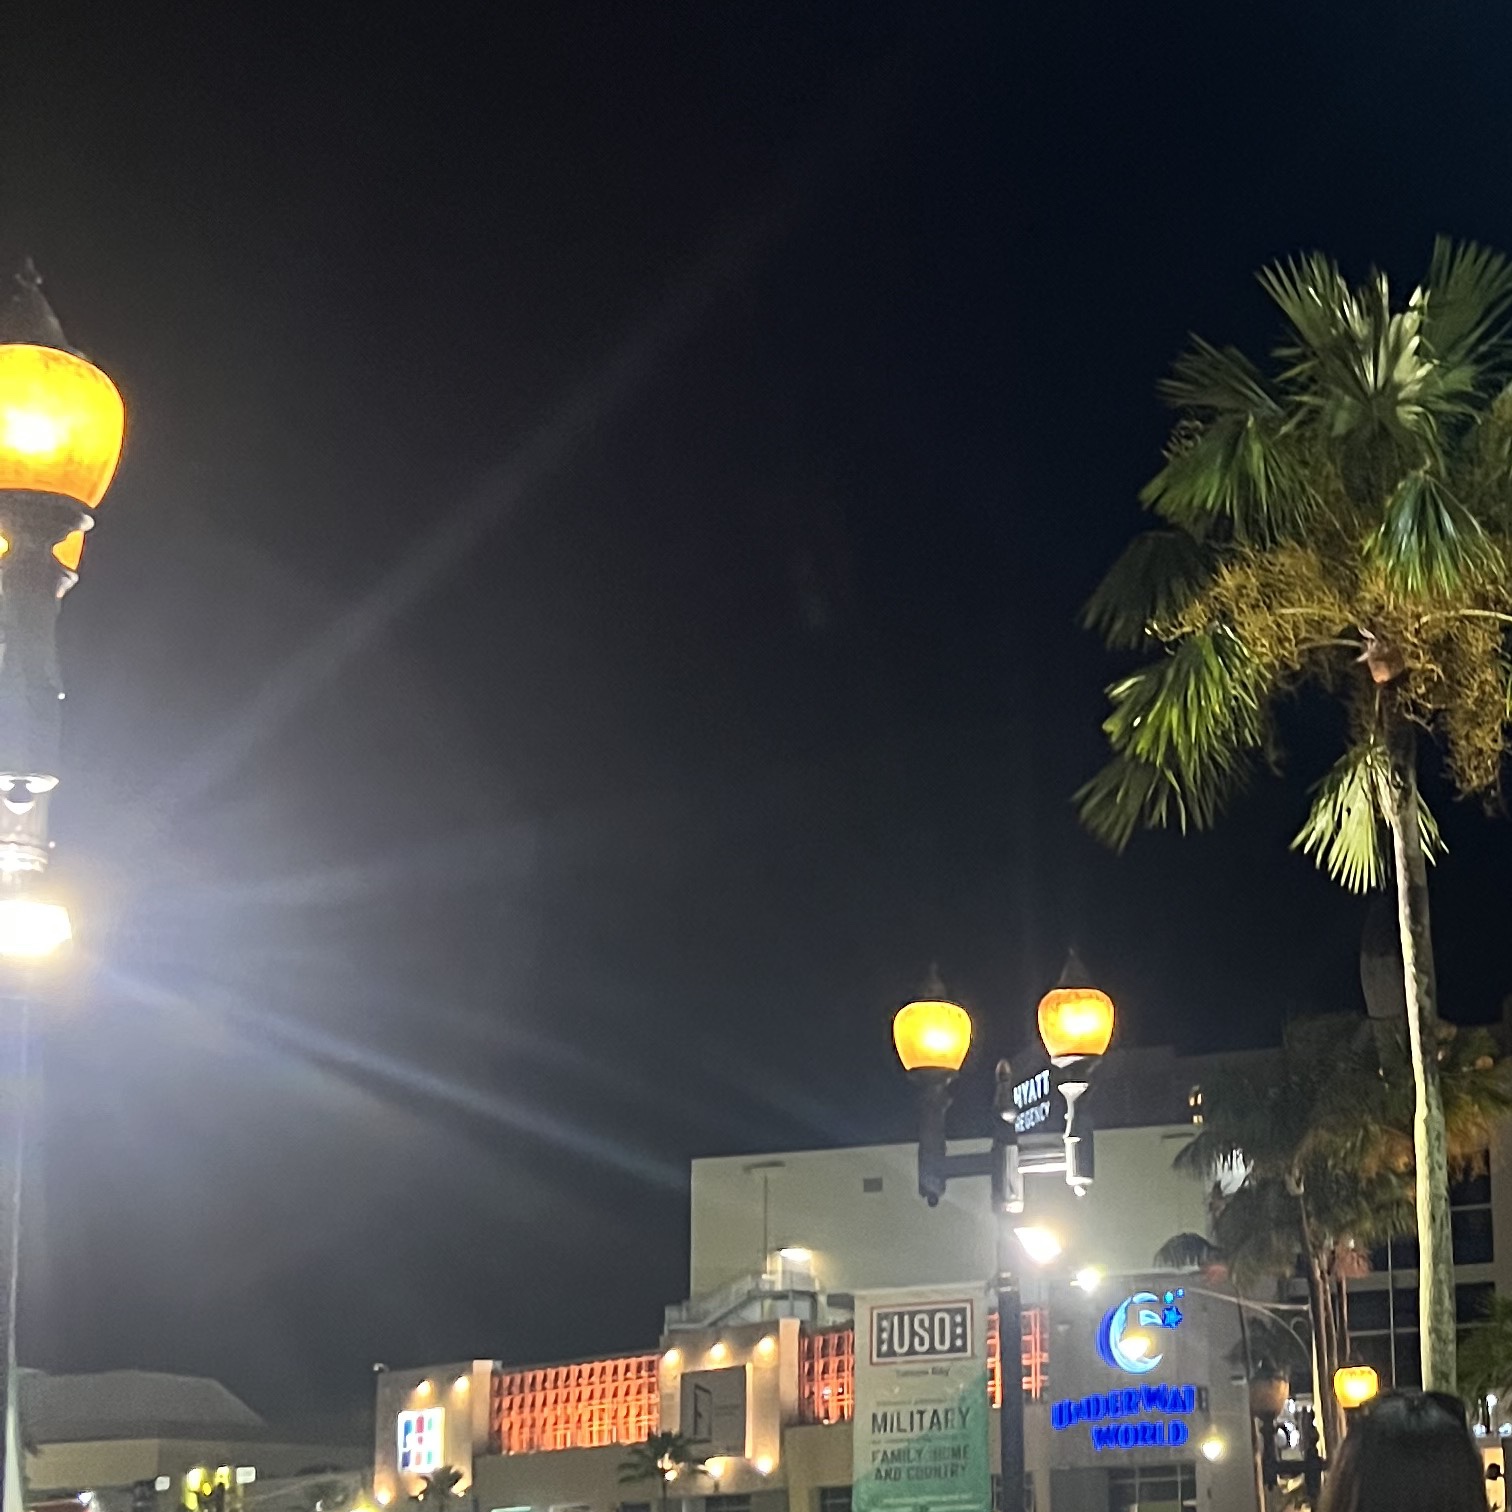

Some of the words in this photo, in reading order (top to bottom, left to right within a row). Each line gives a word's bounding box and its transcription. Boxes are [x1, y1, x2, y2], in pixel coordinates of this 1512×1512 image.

[1013, 1069, 1050, 1109] HYATT
[893, 1312, 951, 1353] USO
[871, 1406, 970, 1434] MILITARY
[1091, 1418, 1189, 1451] WORLD
[871, 1448, 925, 1465] FAMILY
[874, 1466, 900, 1481] AND
[906, 1463, 967, 1480] COUNTRY
